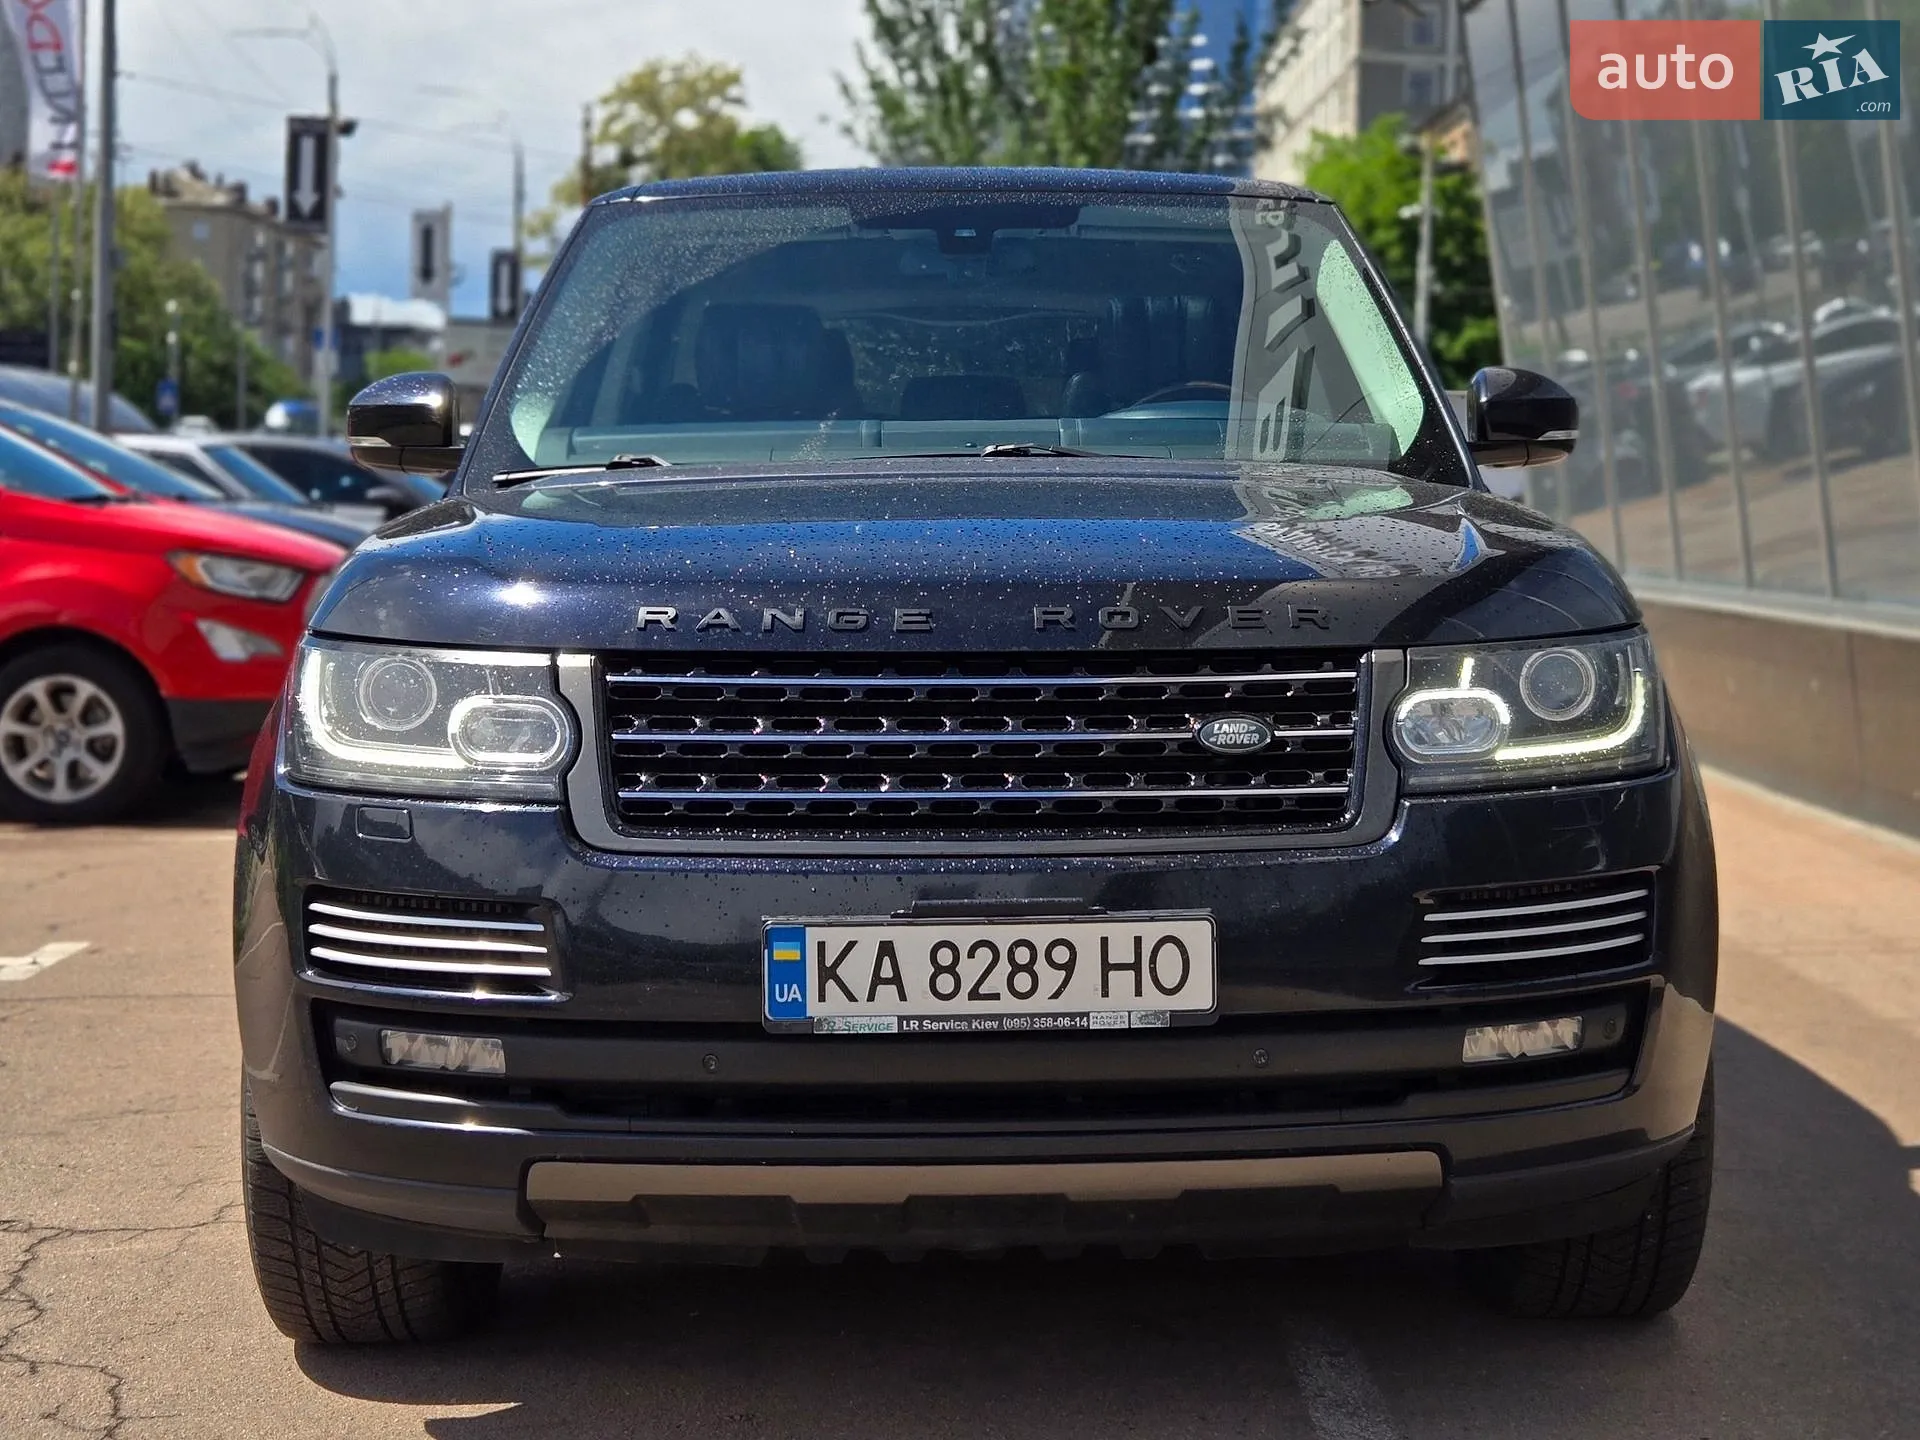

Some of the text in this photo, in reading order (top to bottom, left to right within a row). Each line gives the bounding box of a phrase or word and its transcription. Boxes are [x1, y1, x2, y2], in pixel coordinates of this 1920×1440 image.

[636, 605, 1330, 631] RANGE ROVER
[1213, 723, 1249, 734] LAND
[1216, 733, 1260, 745] ROVER
[817, 935, 1190, 1002] KA 8289 HO
[775, 983, 803, 1002] UA
[902, 1019, 919, 1031] LR
[922, 1018, 968, 1030] Service
[971, 1018, 999, 1029] Kiev
[1033, 1016, 1088, 1028] 358-06-14
